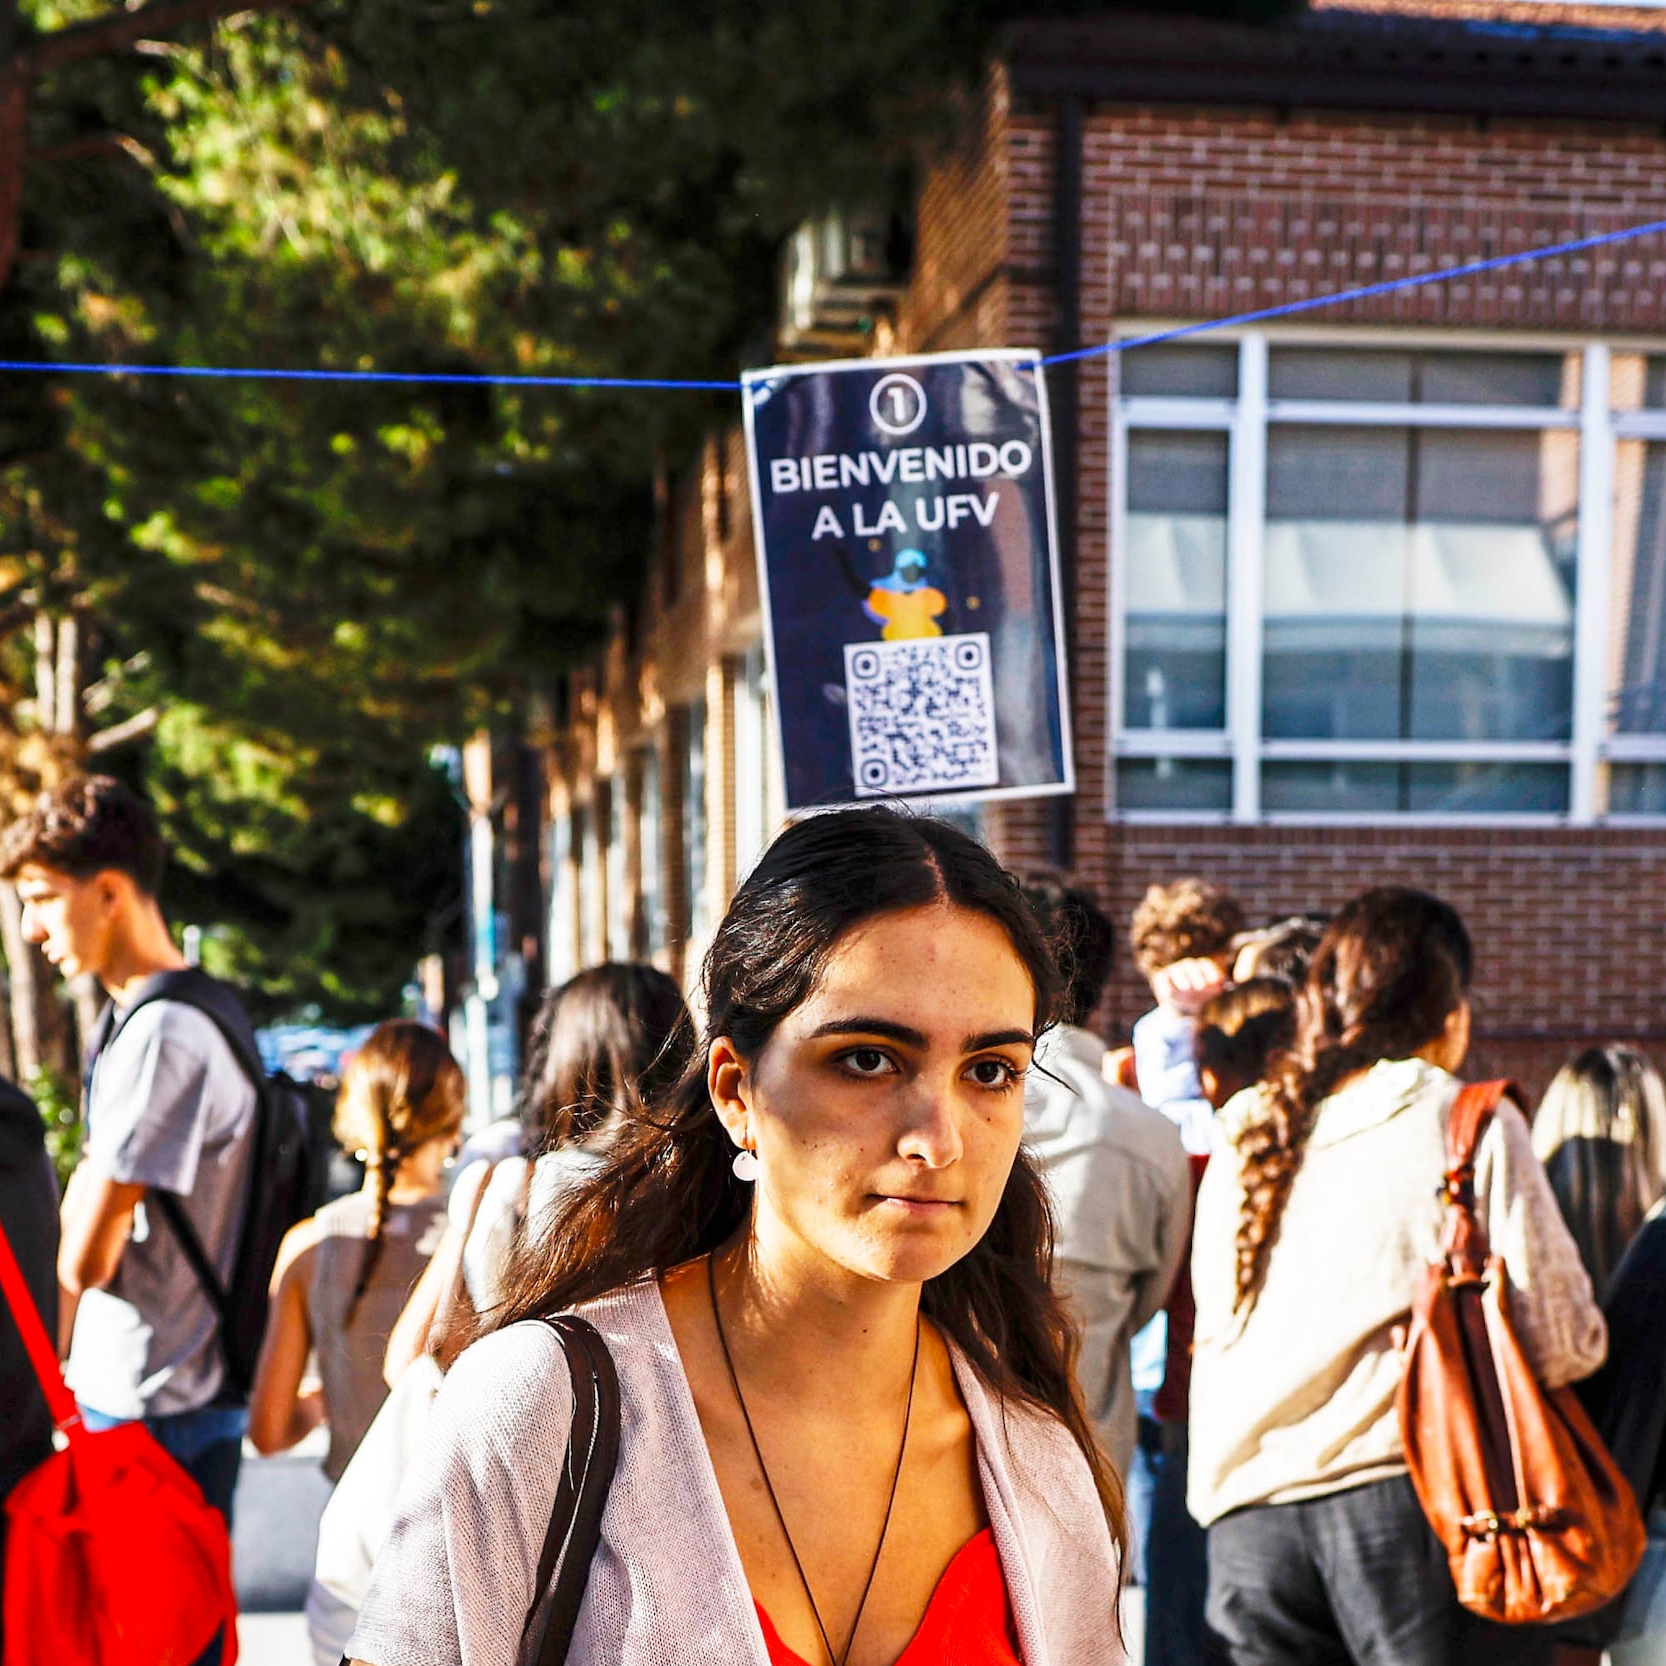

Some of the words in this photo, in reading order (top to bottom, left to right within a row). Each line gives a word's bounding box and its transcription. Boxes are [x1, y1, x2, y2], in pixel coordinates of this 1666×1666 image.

[887, 387, 906, 422] 1
[770, 440, 1033, 494] BIENVENIDO
[812, 506, 844, 541] A
[853, 499, 907, 537] LA
[916, 492, 1000, 531] UFV
